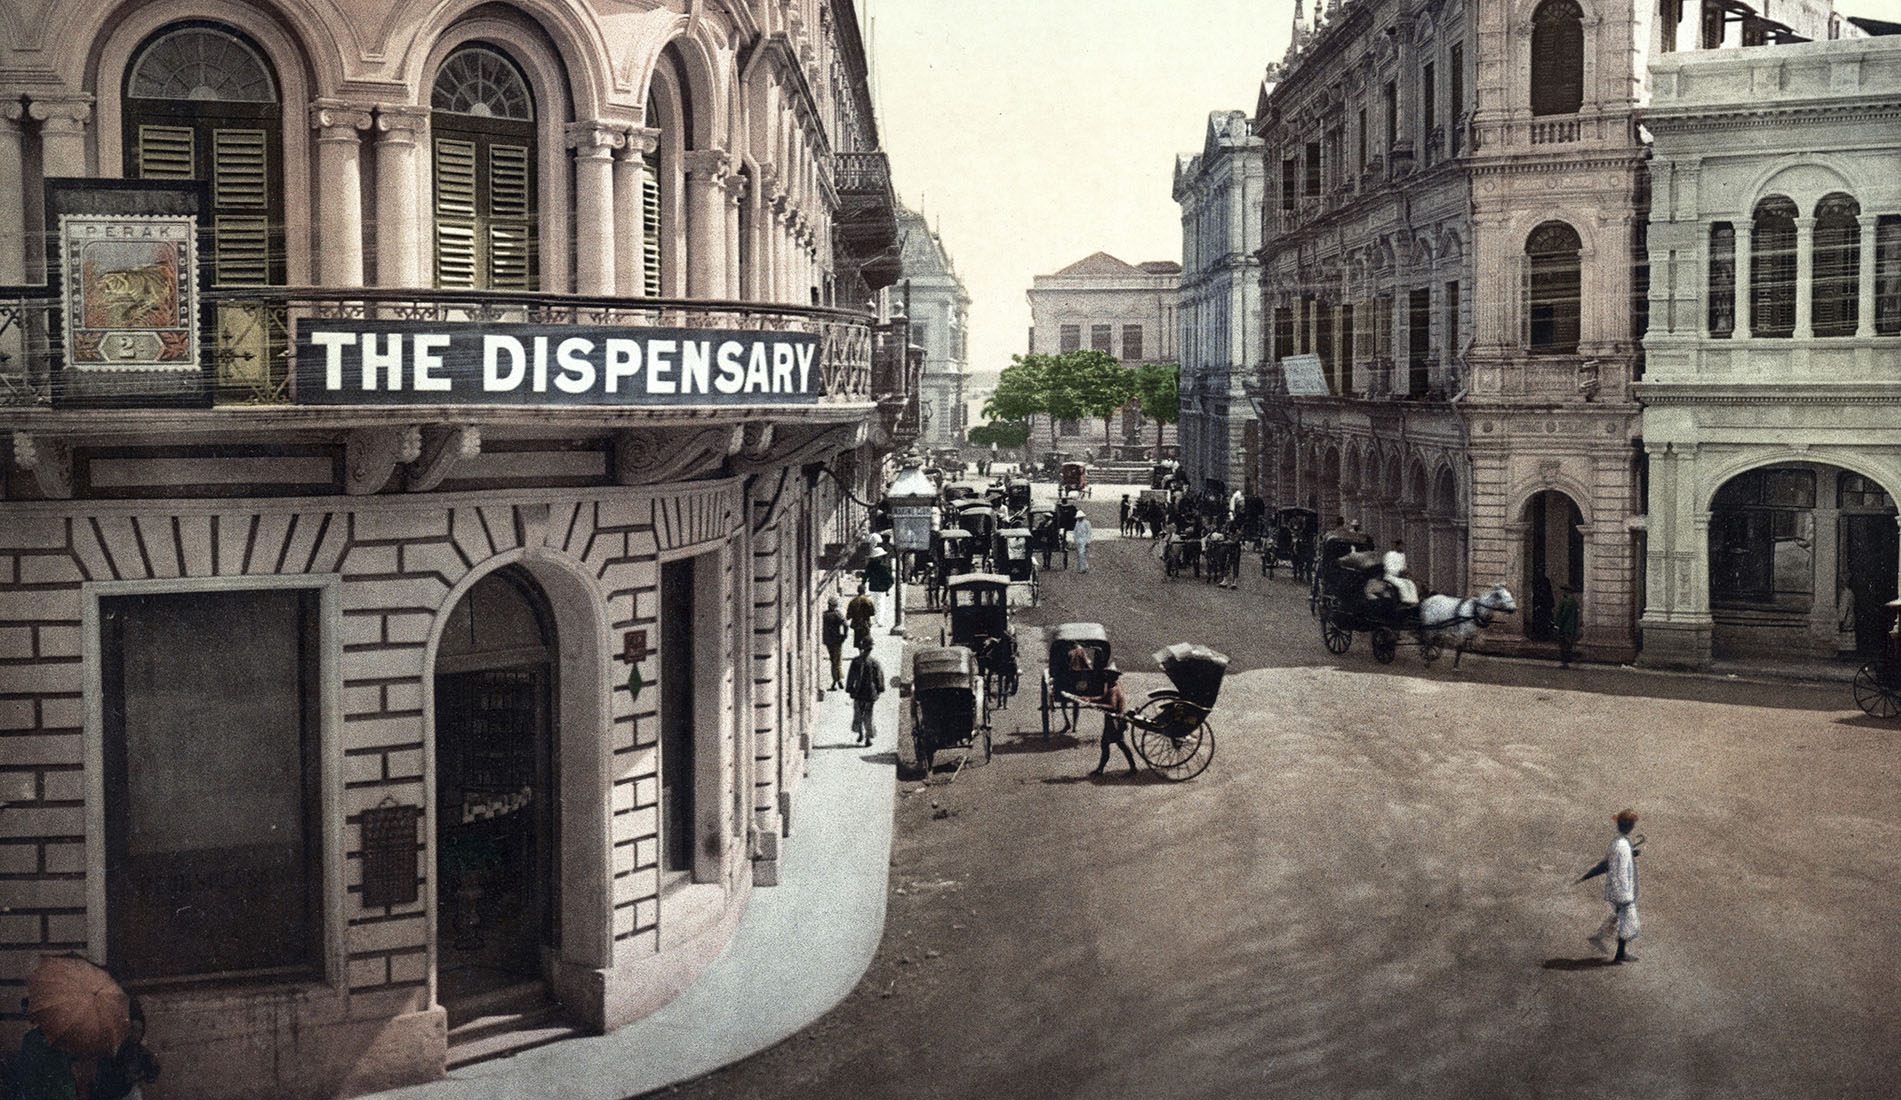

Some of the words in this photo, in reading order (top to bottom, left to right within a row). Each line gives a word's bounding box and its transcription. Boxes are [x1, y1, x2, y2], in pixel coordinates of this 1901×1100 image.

[86, 226, 170, 238] PERAK
[178, 243, 188, 325] POSTAGE
[311, 331, 452, 392] THE
[483, 334, 815, 395] DISPENSARY
